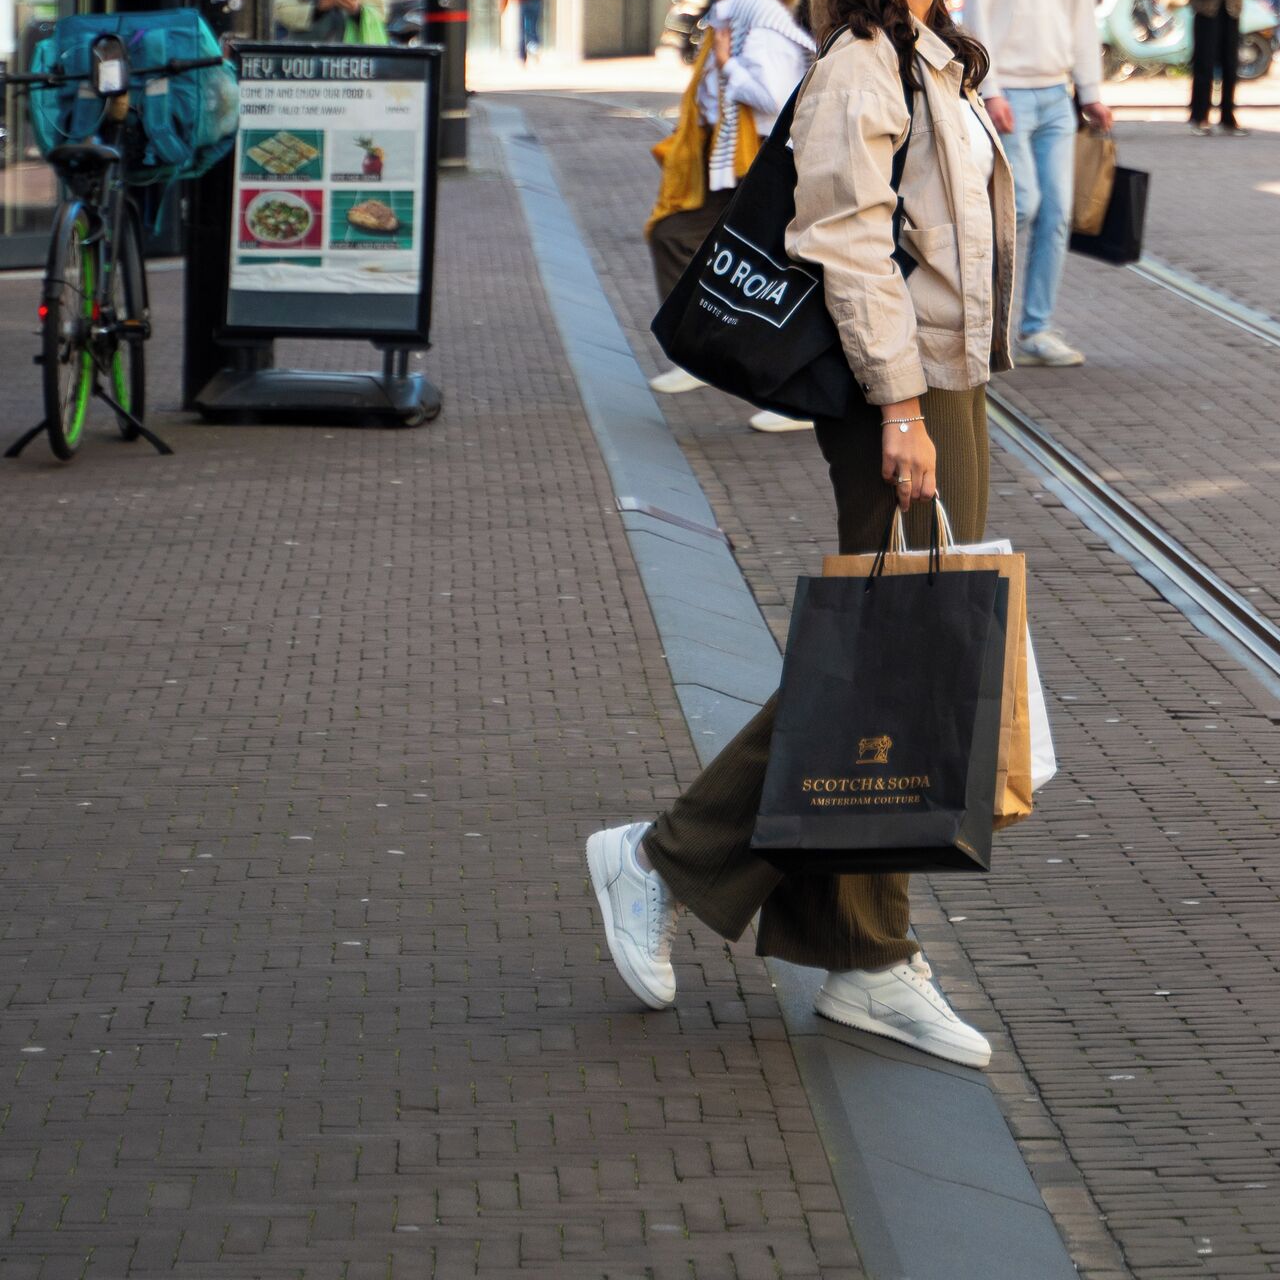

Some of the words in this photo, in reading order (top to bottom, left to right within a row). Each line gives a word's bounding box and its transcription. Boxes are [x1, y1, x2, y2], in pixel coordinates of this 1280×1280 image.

[282, 56, 314, 79] YOU
[810, 796, 872, 807] AMSTERDAM
[873, 795, 921, 805] COUTURE
